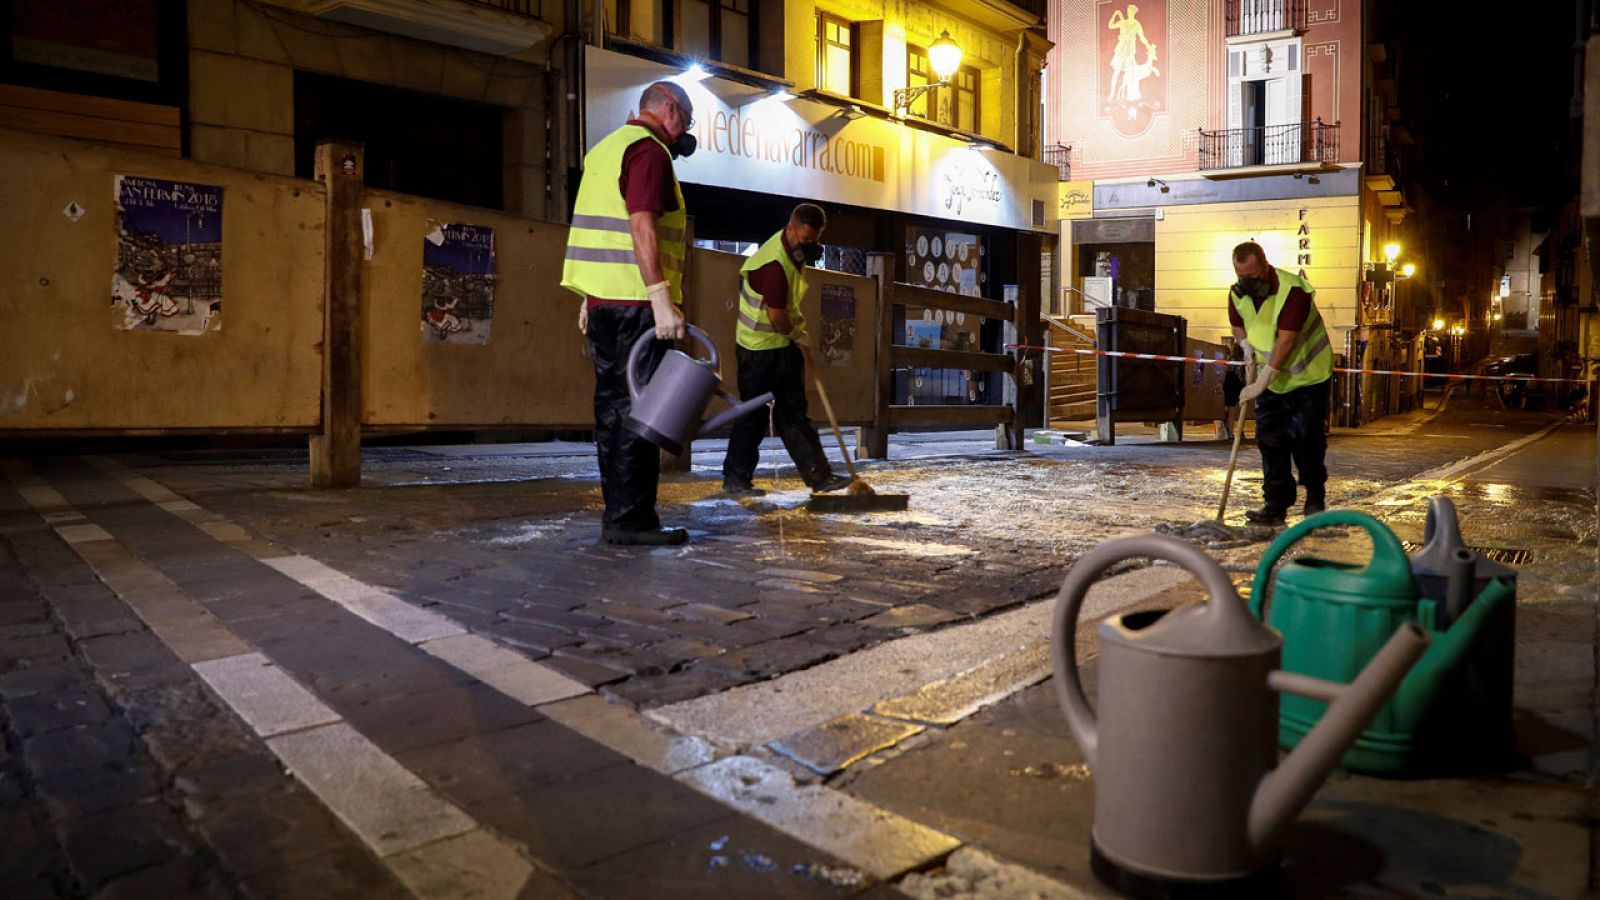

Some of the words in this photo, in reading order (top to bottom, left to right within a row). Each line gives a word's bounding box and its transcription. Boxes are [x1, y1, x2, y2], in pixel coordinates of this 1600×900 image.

[188, 192, 218, 206] 2018
[917, 238, 967, 260] VIVA
[925, 262, 961, 282] SAN
